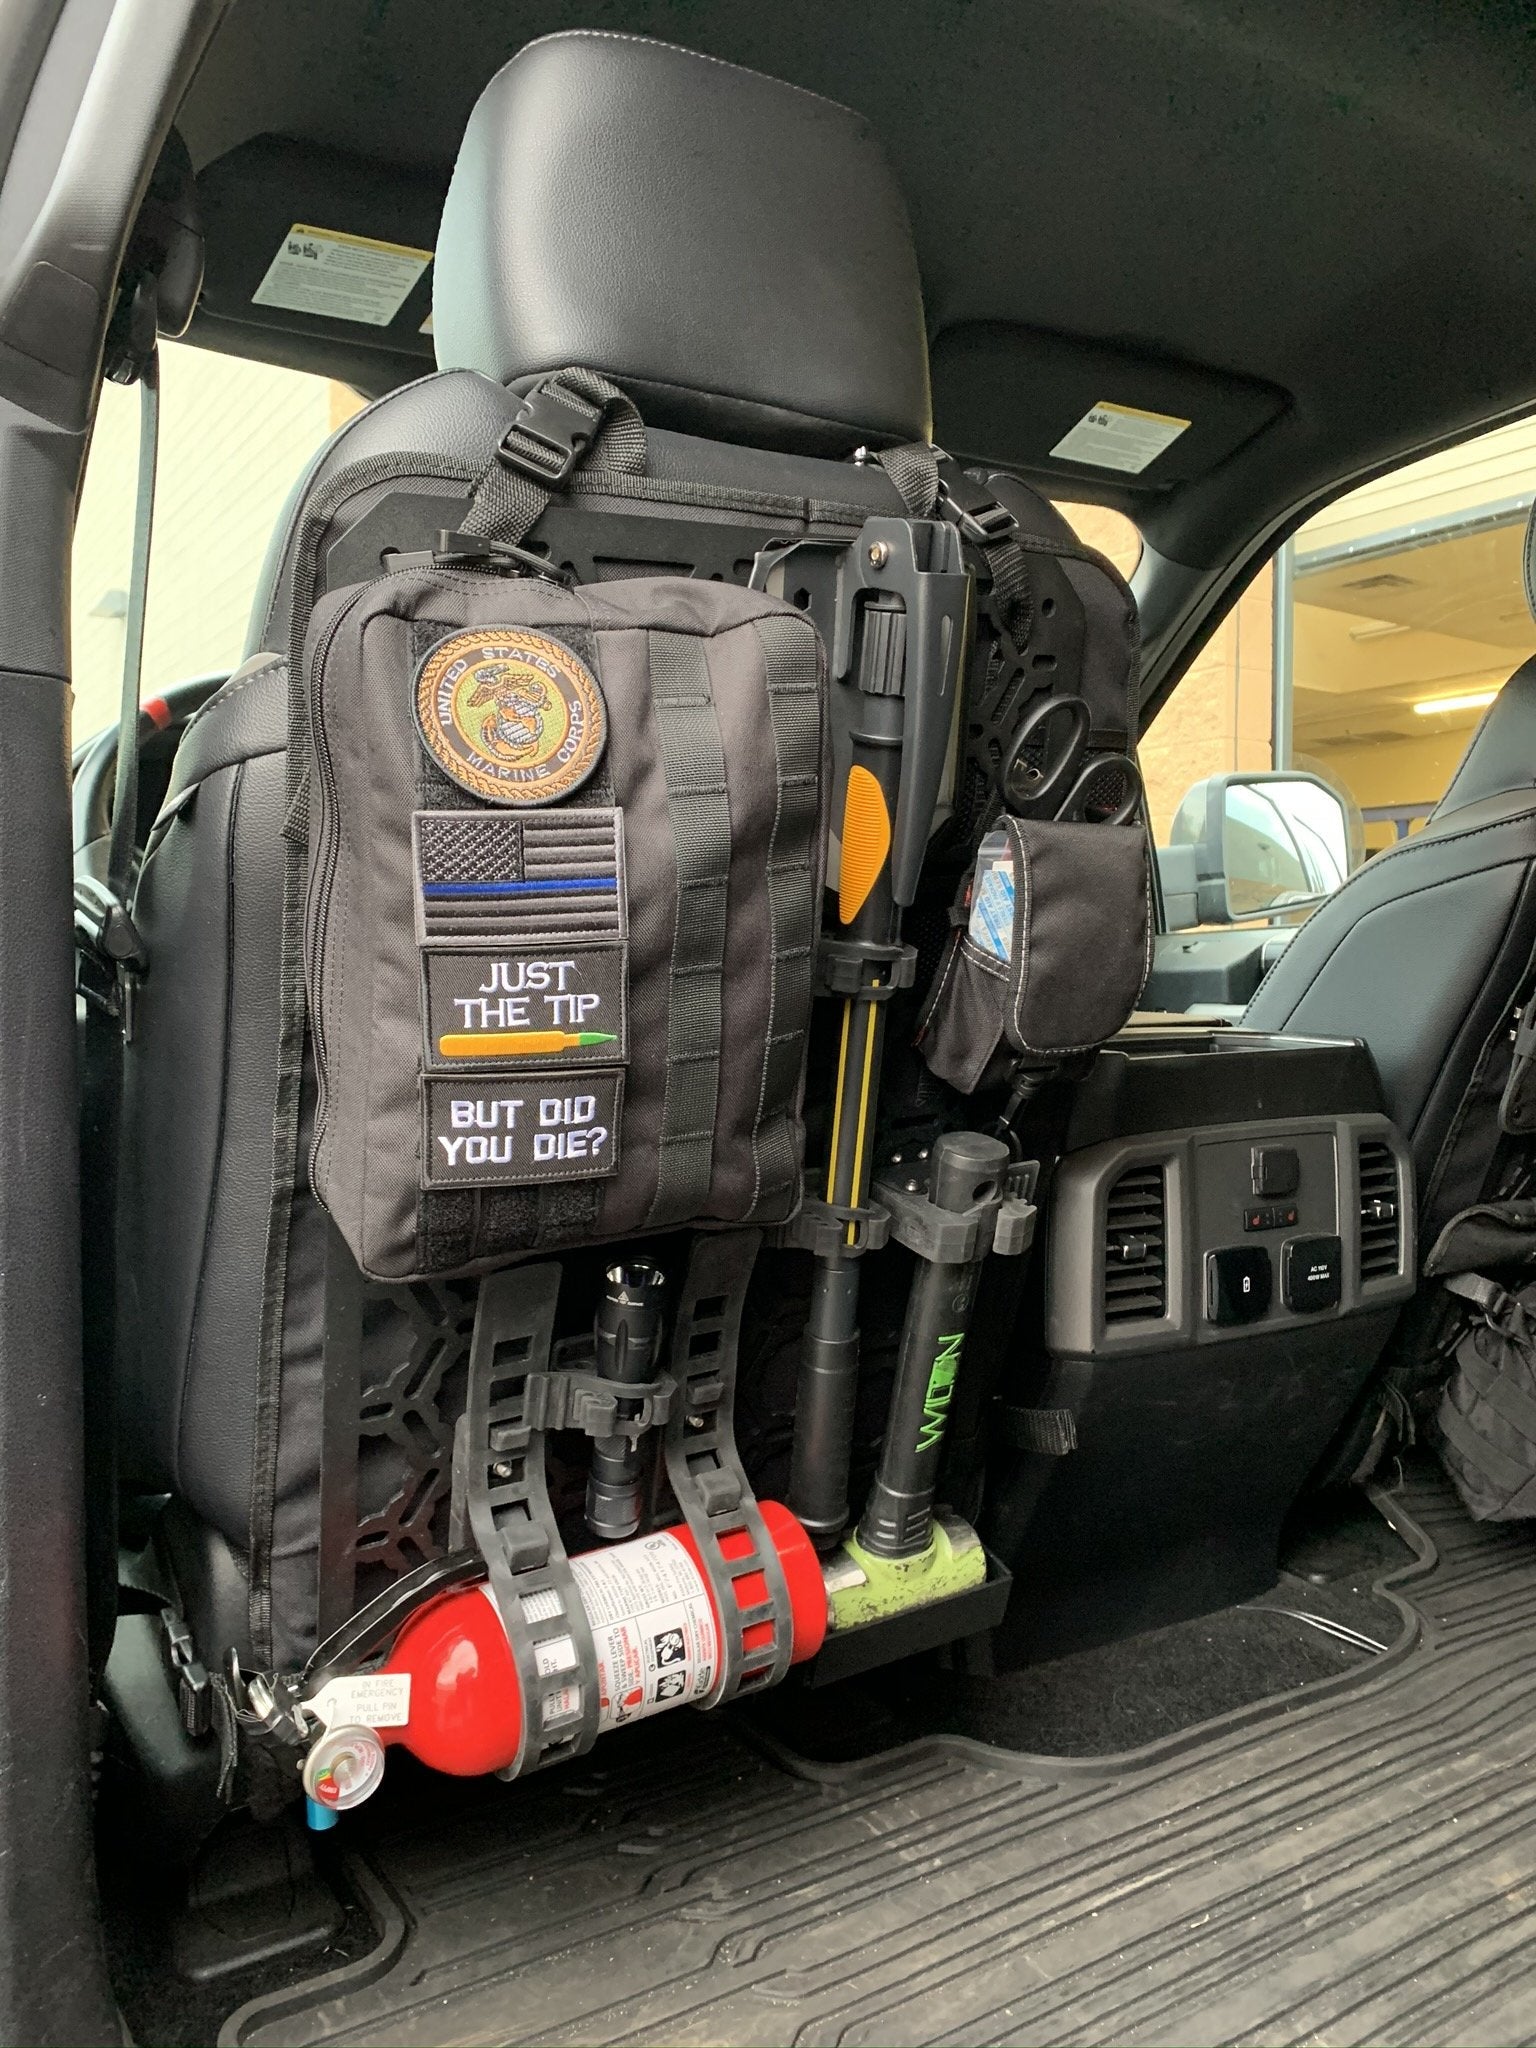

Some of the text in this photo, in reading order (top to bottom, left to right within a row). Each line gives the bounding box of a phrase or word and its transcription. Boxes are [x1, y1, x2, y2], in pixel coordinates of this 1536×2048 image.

[438, 647, 561, 725] UNITED STATES
[466, 700, 584, 781] MARINE CORPS
[479, 960, 576, 993] JUST
[454, 993, 600, 1028] THE TIP
[450, 1095, 596, 1128] BUT DID
[437, 1126, 608, 1166] YOU DIE?
[608, 1636, 617, 1659] LEVER
[351, 1687, 404, 1699] EMERGENCY
[375, 1679, 394, 1688] FIRE
[350, 1712, 402, 1724] TO REMOVE
[356, 1702, 398, 1712] PULL PIN
